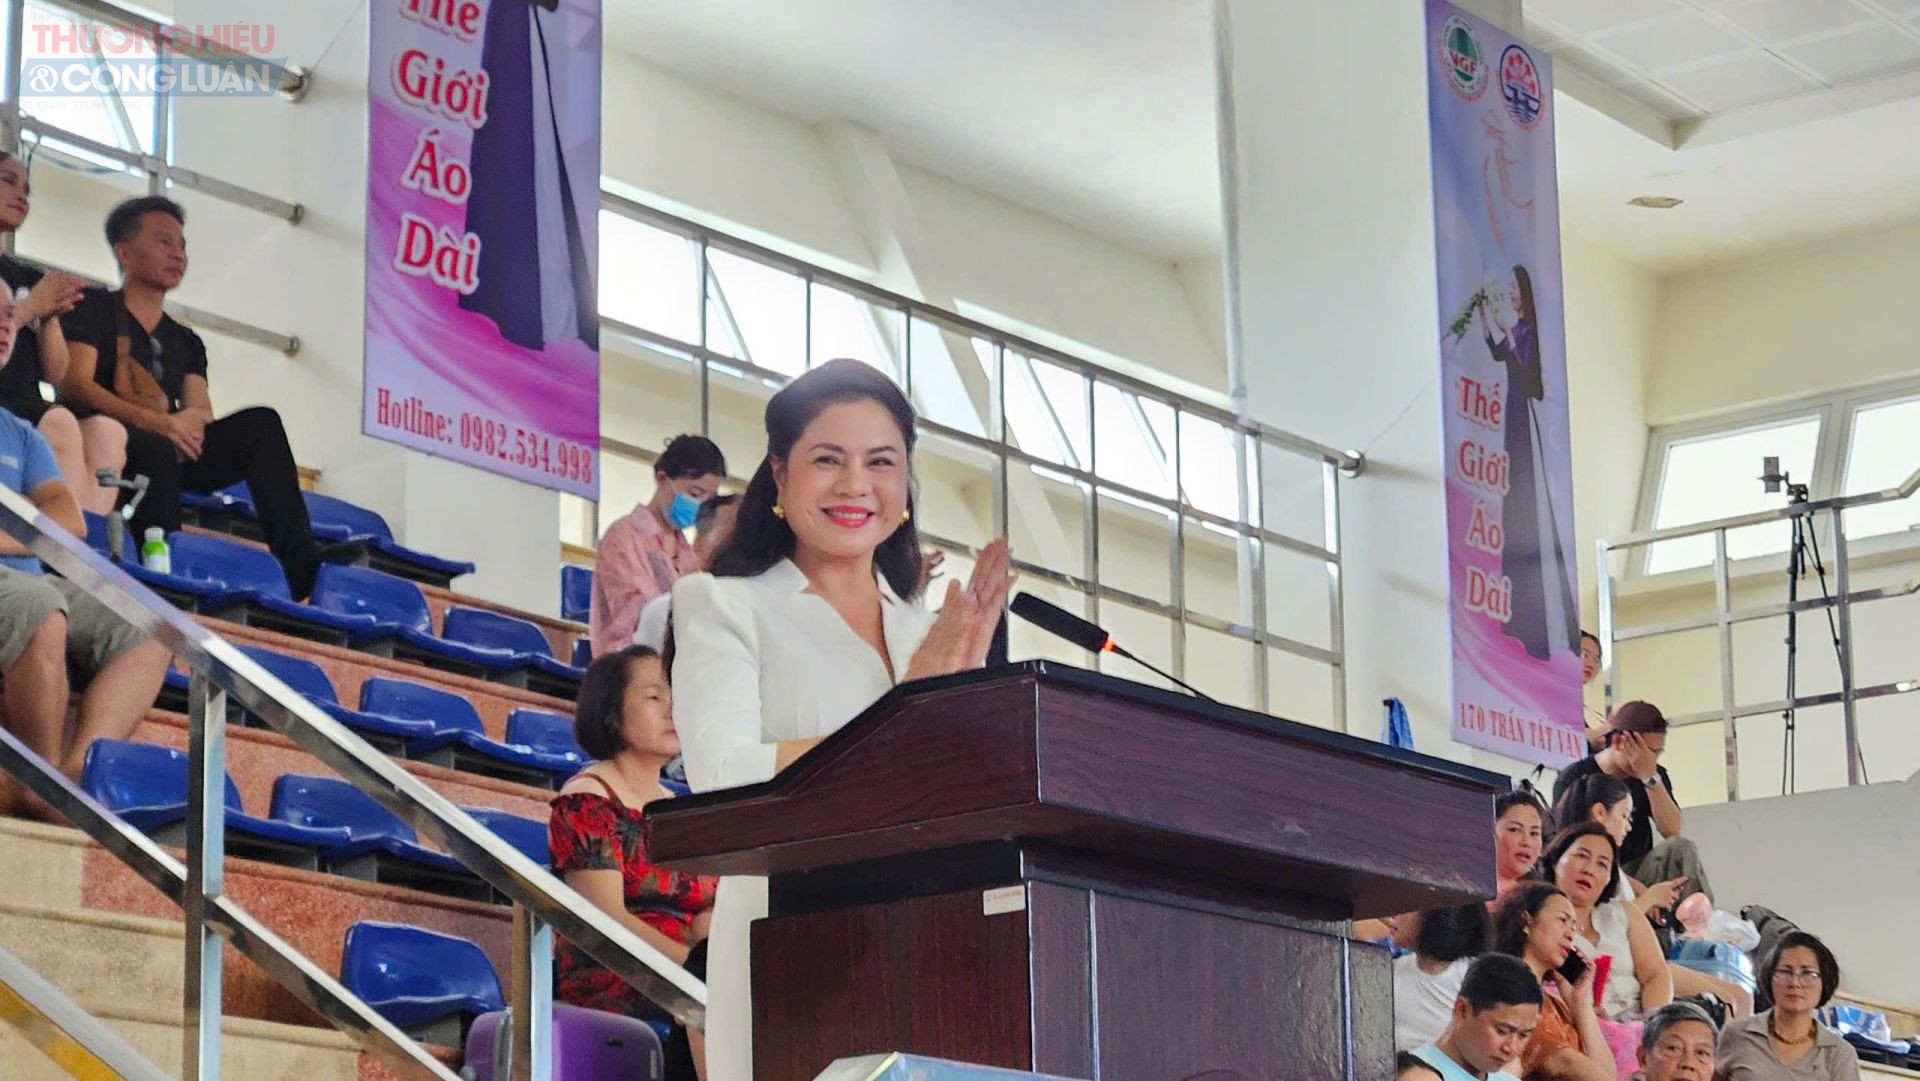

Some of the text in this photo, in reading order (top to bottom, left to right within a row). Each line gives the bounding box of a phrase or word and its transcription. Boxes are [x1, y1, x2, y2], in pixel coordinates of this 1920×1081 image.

[399, 49, 485, 121] Giới
[409, 128, 467, 197] Áo
[401, 219, 478, 286] Dài
[1459, 376, 1502, 425] Thế
[377, 387, 592, 484] Hotline: 0982.534.998
[1459, 440, 1509, 490] Giới
[1469, 500, 1502, 550] Áo
[1467, 569, 1509, 616] Dài
[1460, 702, 1486, 733] 170
